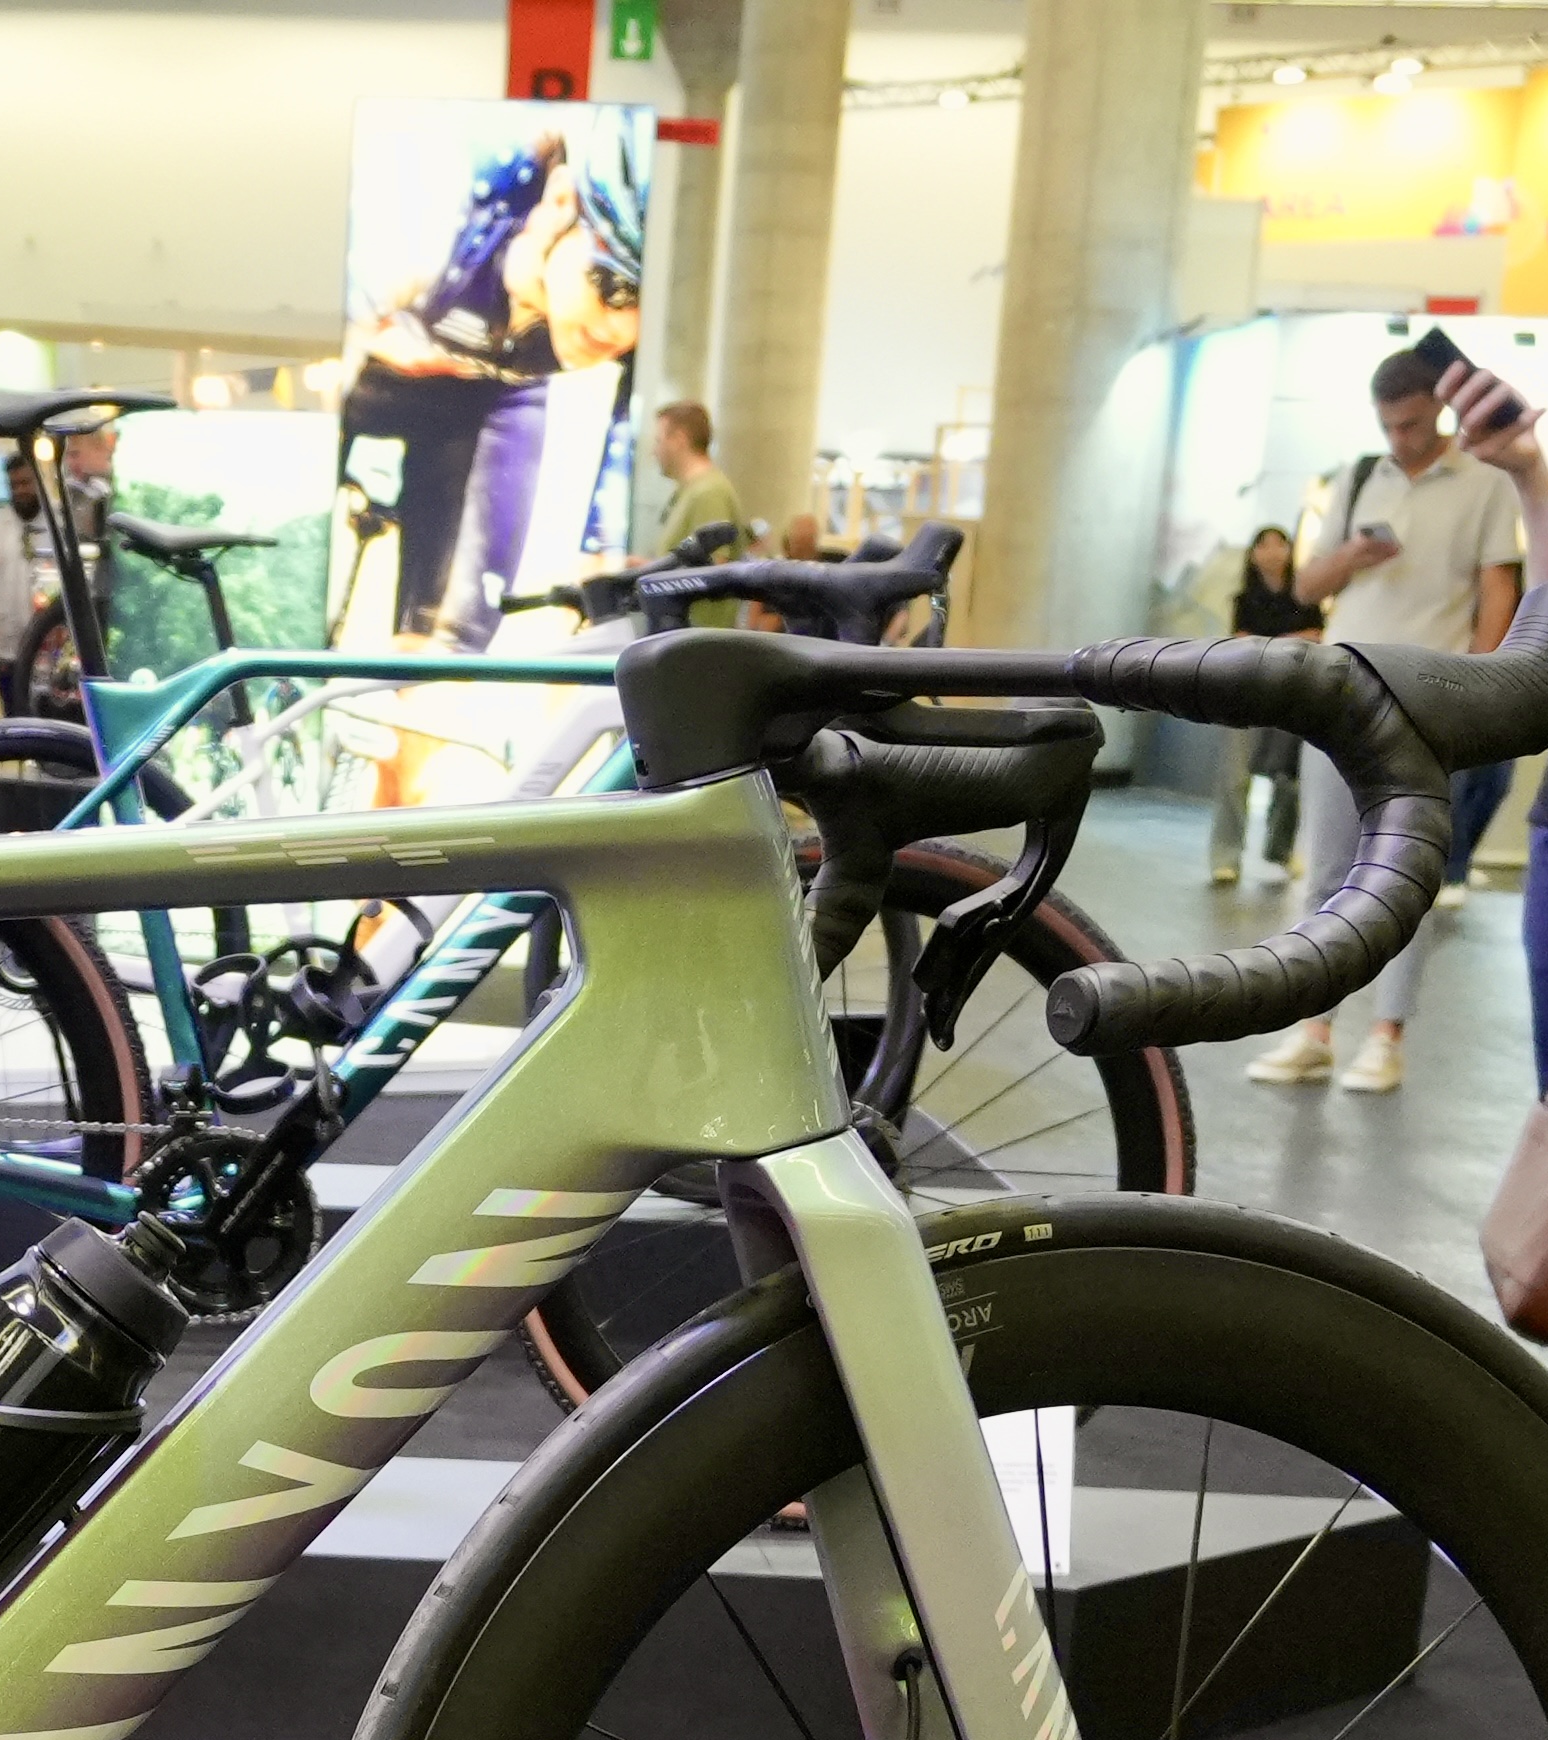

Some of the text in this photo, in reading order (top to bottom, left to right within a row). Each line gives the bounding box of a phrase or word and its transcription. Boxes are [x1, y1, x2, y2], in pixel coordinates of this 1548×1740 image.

[641, 576, 707, 595] CANYON
[348, 903, 533, 1069] CANY
[925, 1231, 1002, 1263] ERO
